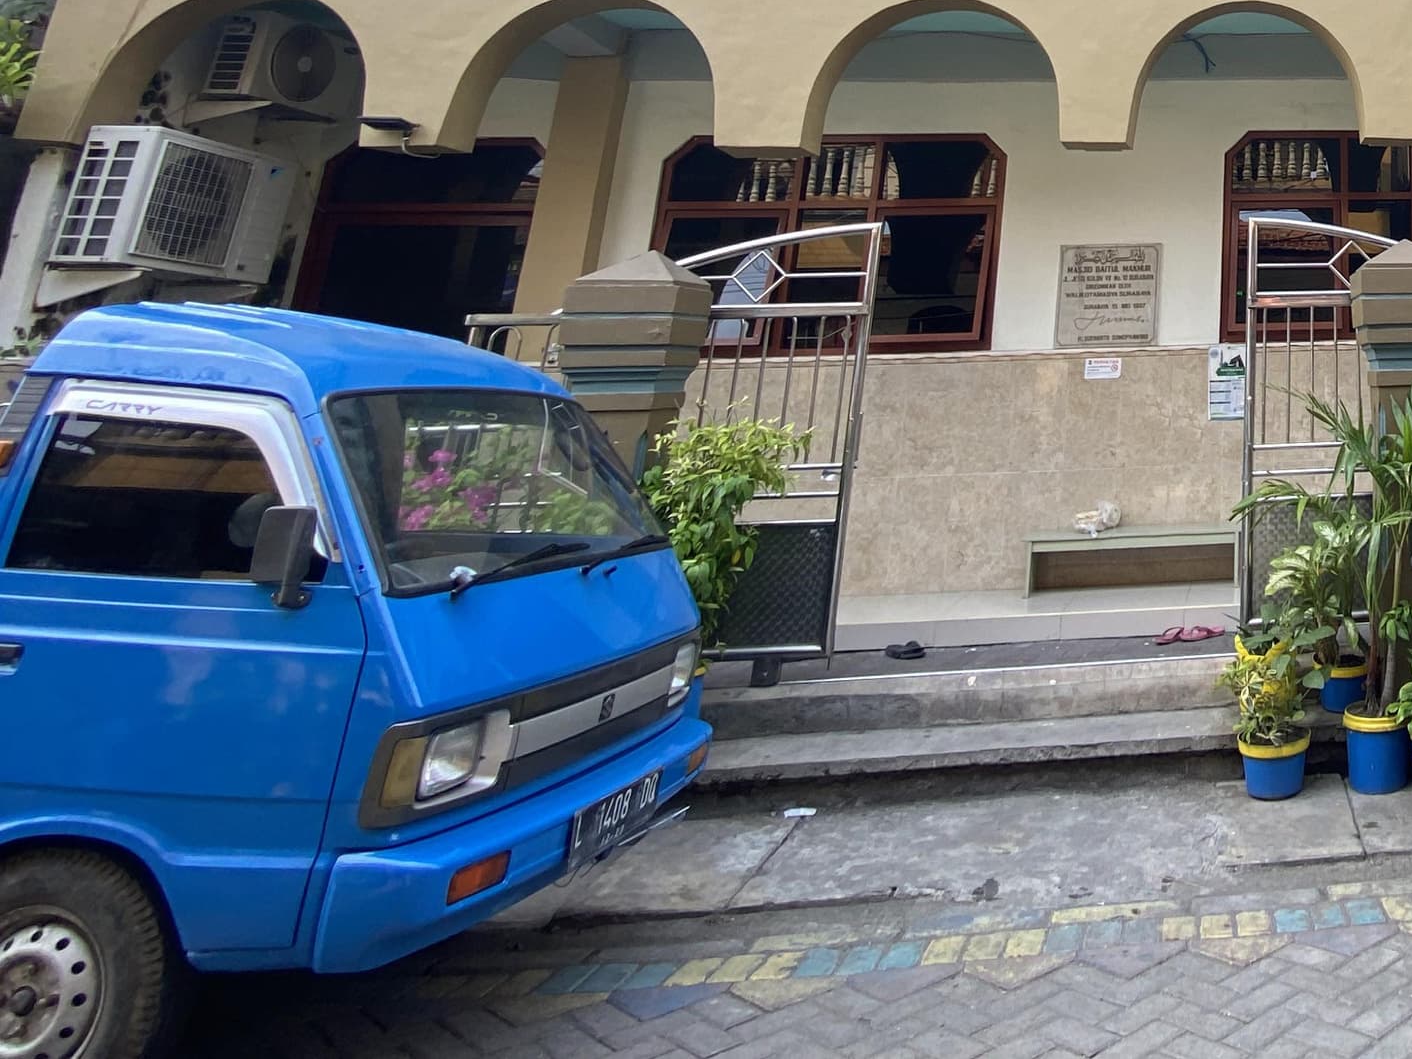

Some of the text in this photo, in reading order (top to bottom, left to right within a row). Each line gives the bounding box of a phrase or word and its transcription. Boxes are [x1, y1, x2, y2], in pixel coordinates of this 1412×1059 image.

[86, 399, 163, 415] CARRY
[574, 814, 582, 849] L
[598, 788, 632, 834] 1408
